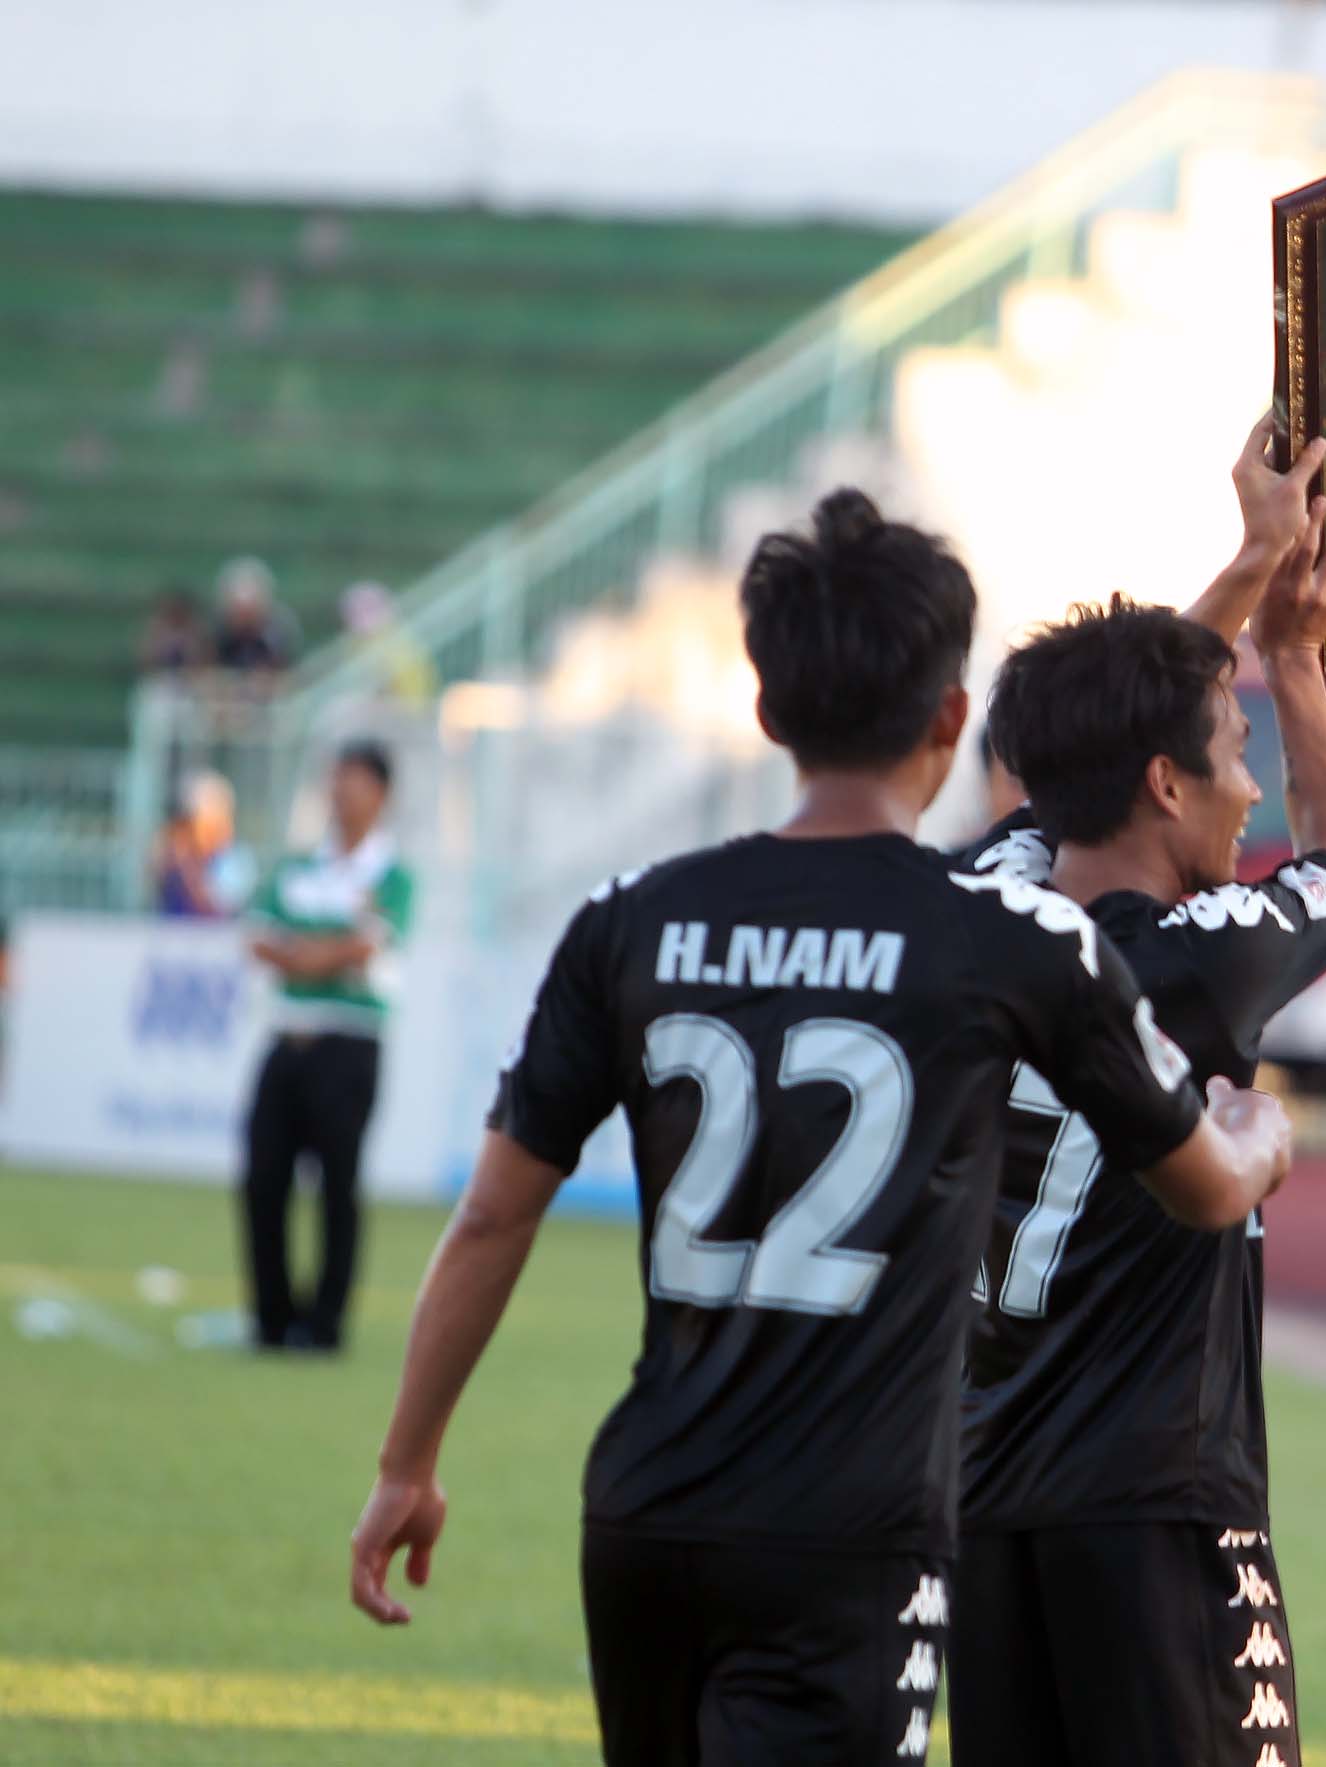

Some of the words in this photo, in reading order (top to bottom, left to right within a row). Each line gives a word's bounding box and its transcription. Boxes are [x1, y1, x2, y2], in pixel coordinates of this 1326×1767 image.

[654, 920, 906, 994] H.NAM
[642, 1012, 916, 1316] 22
[970, 1057, 1104, 1319] 7
